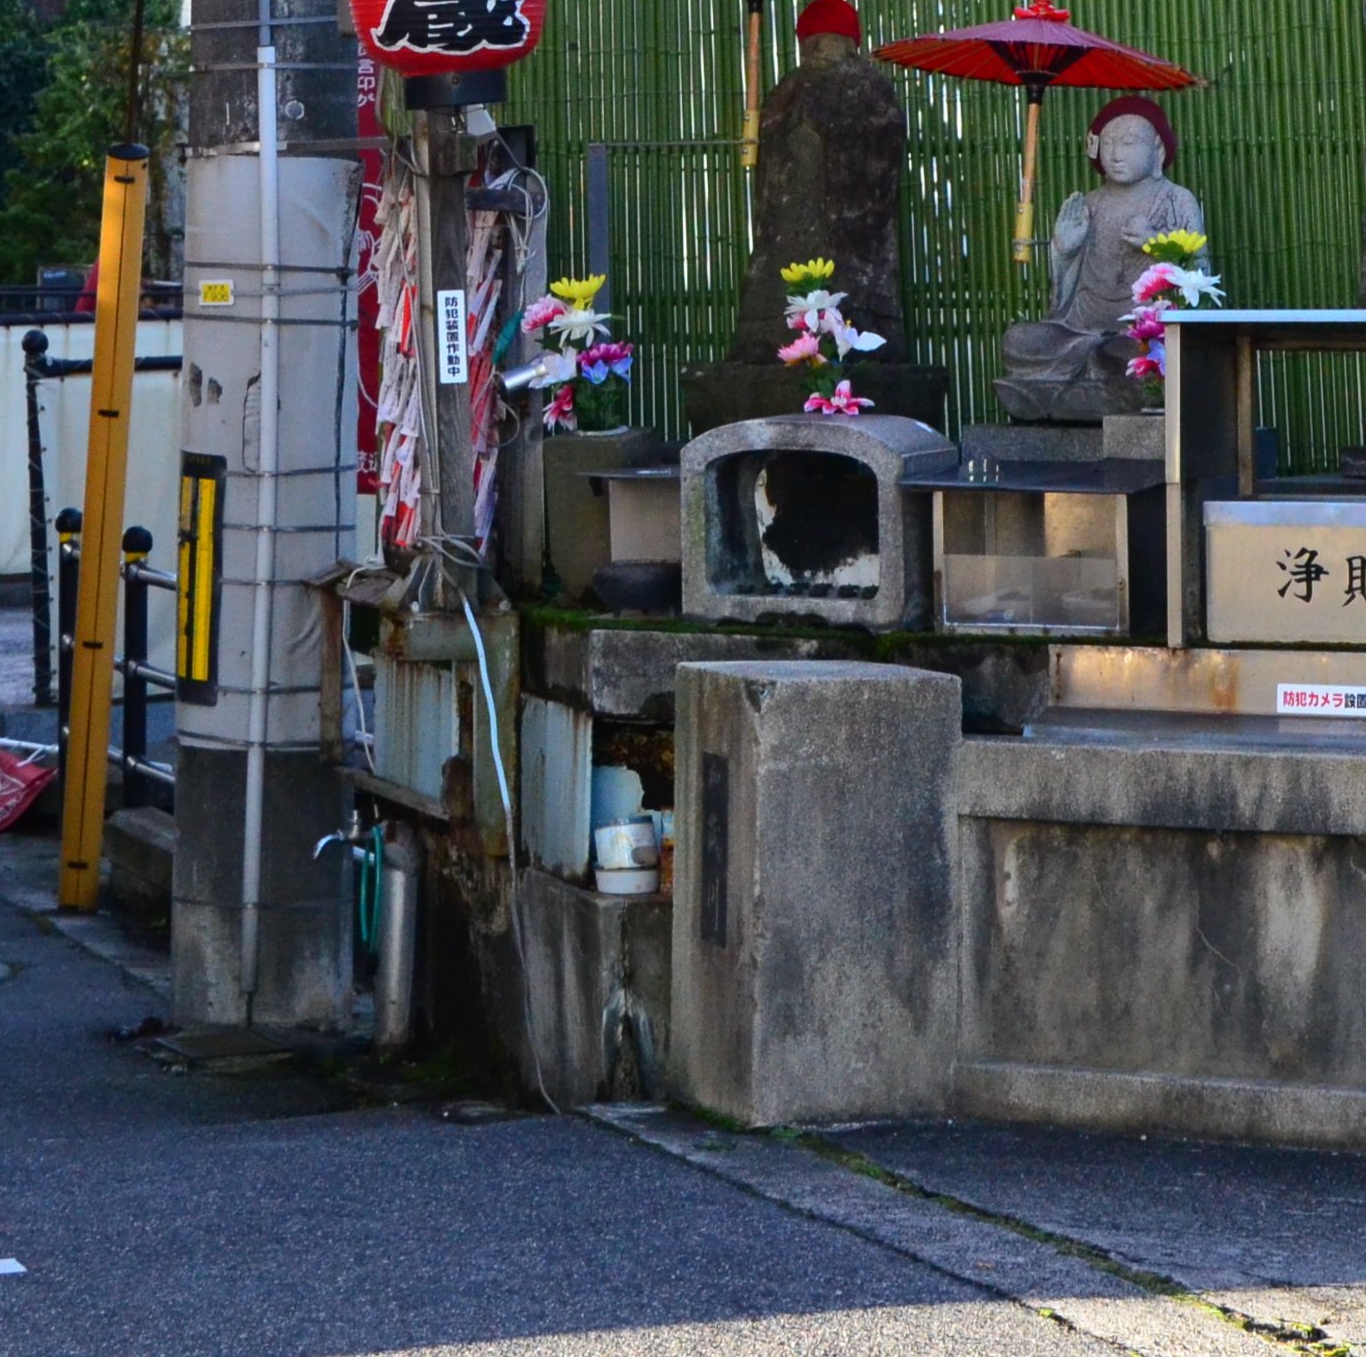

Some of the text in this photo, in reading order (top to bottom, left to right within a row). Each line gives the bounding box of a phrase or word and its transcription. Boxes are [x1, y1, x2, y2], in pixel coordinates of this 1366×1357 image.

[444, 296, 461, 378] 防犯装置作動中
